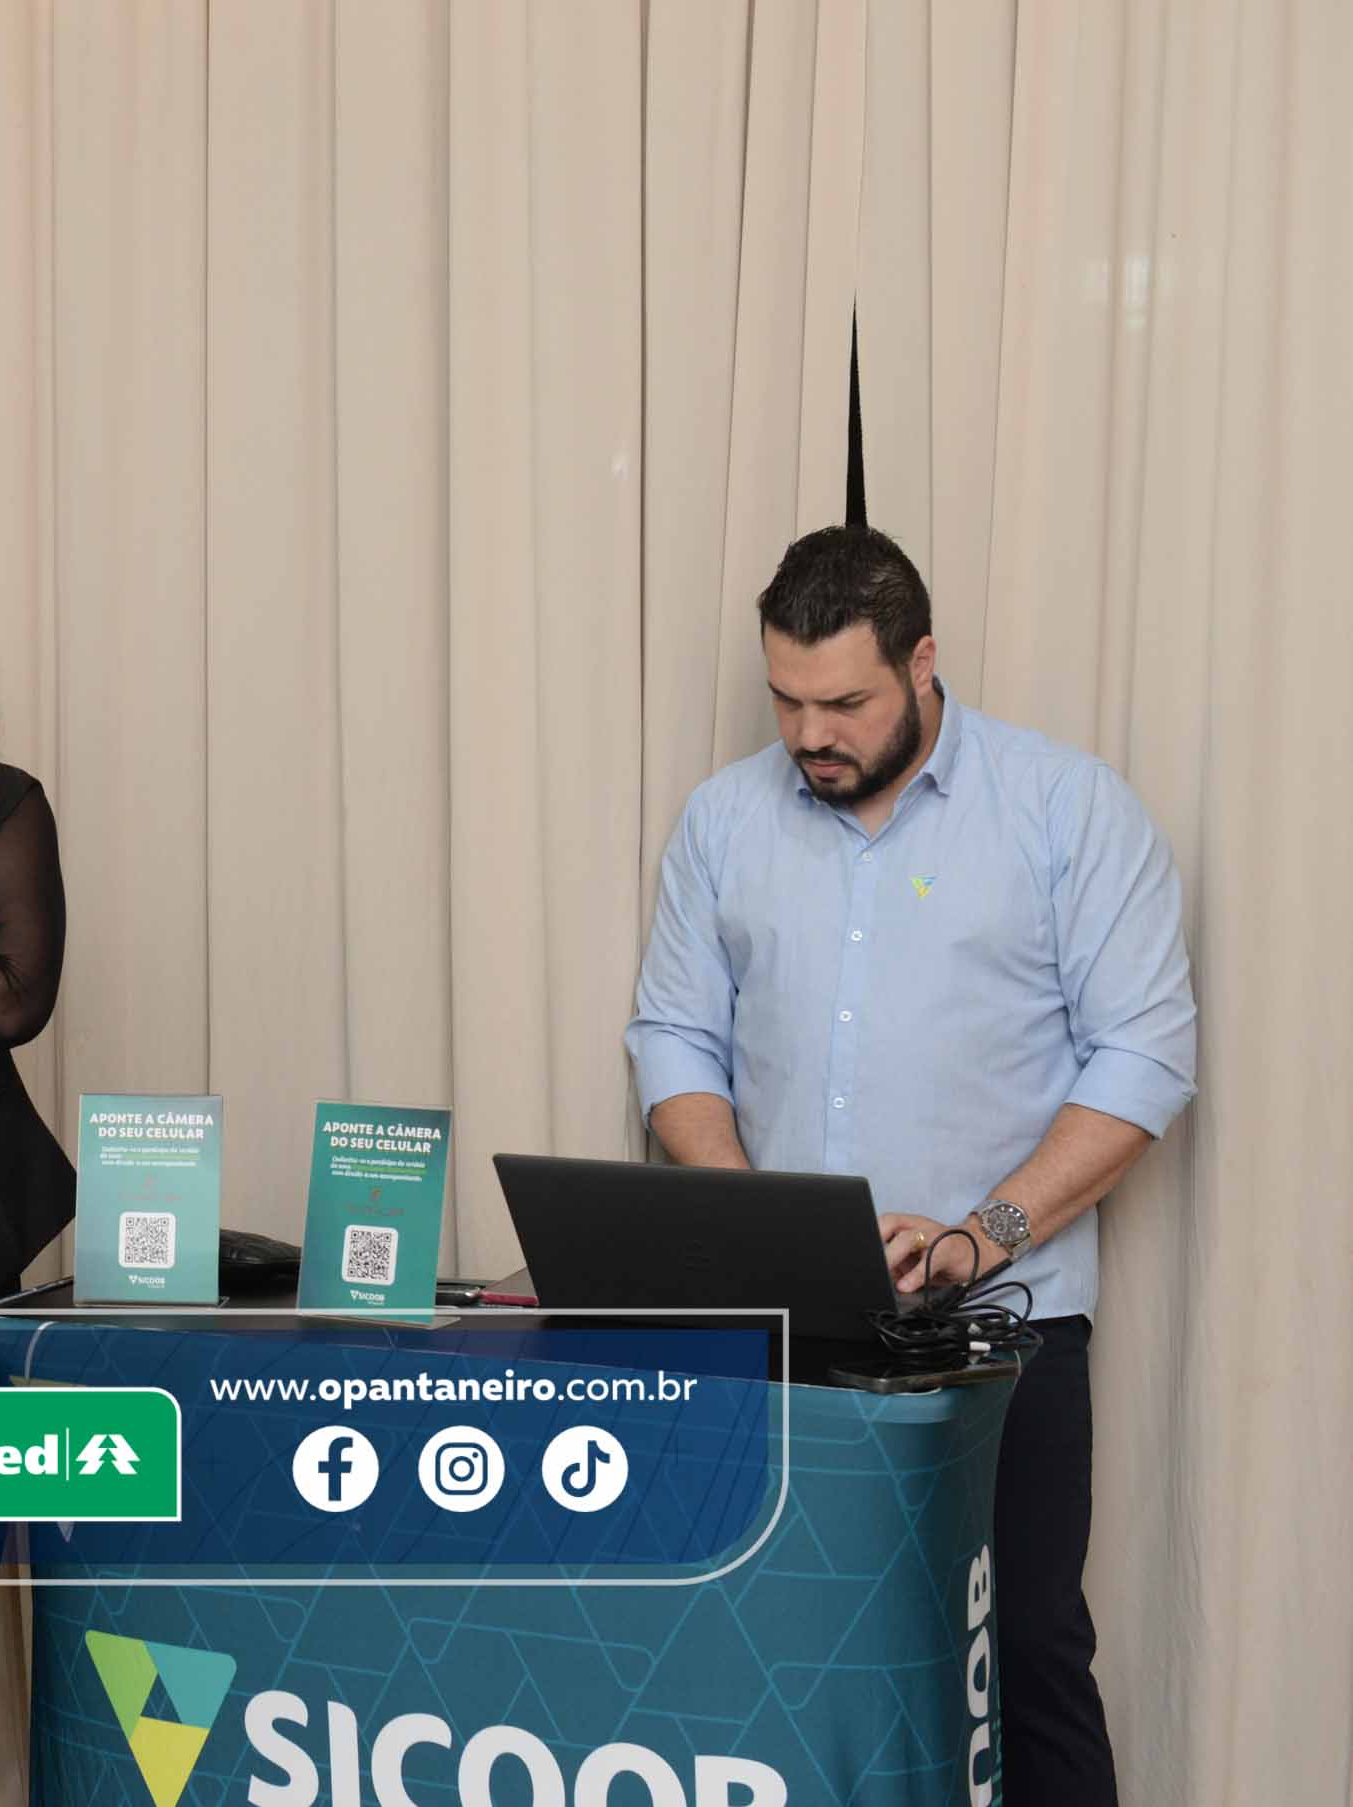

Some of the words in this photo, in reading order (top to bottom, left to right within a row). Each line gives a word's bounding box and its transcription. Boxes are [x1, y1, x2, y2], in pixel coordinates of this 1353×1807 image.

[89, 1112, 143, 1124] APONTE
[145, 1113, 155, 1124] A
[157, 1111, 214, 1126] CÂMERA
[98, 1126, 117, 1137] DO
[119, 1127, 144, 1138] SEU
[146, 1127, 204, 1139] CELULAR
[322, 1121, 374, 1135] APONTE
[375, 1124, 385, 1136] A
[387, 1123, 442, 1140] CÂMERA
[330, 1135, 348, 1147] DO
[350, 1137, 374, 1149] SEU
[376, 1139, 431, 1153] CELULAR
